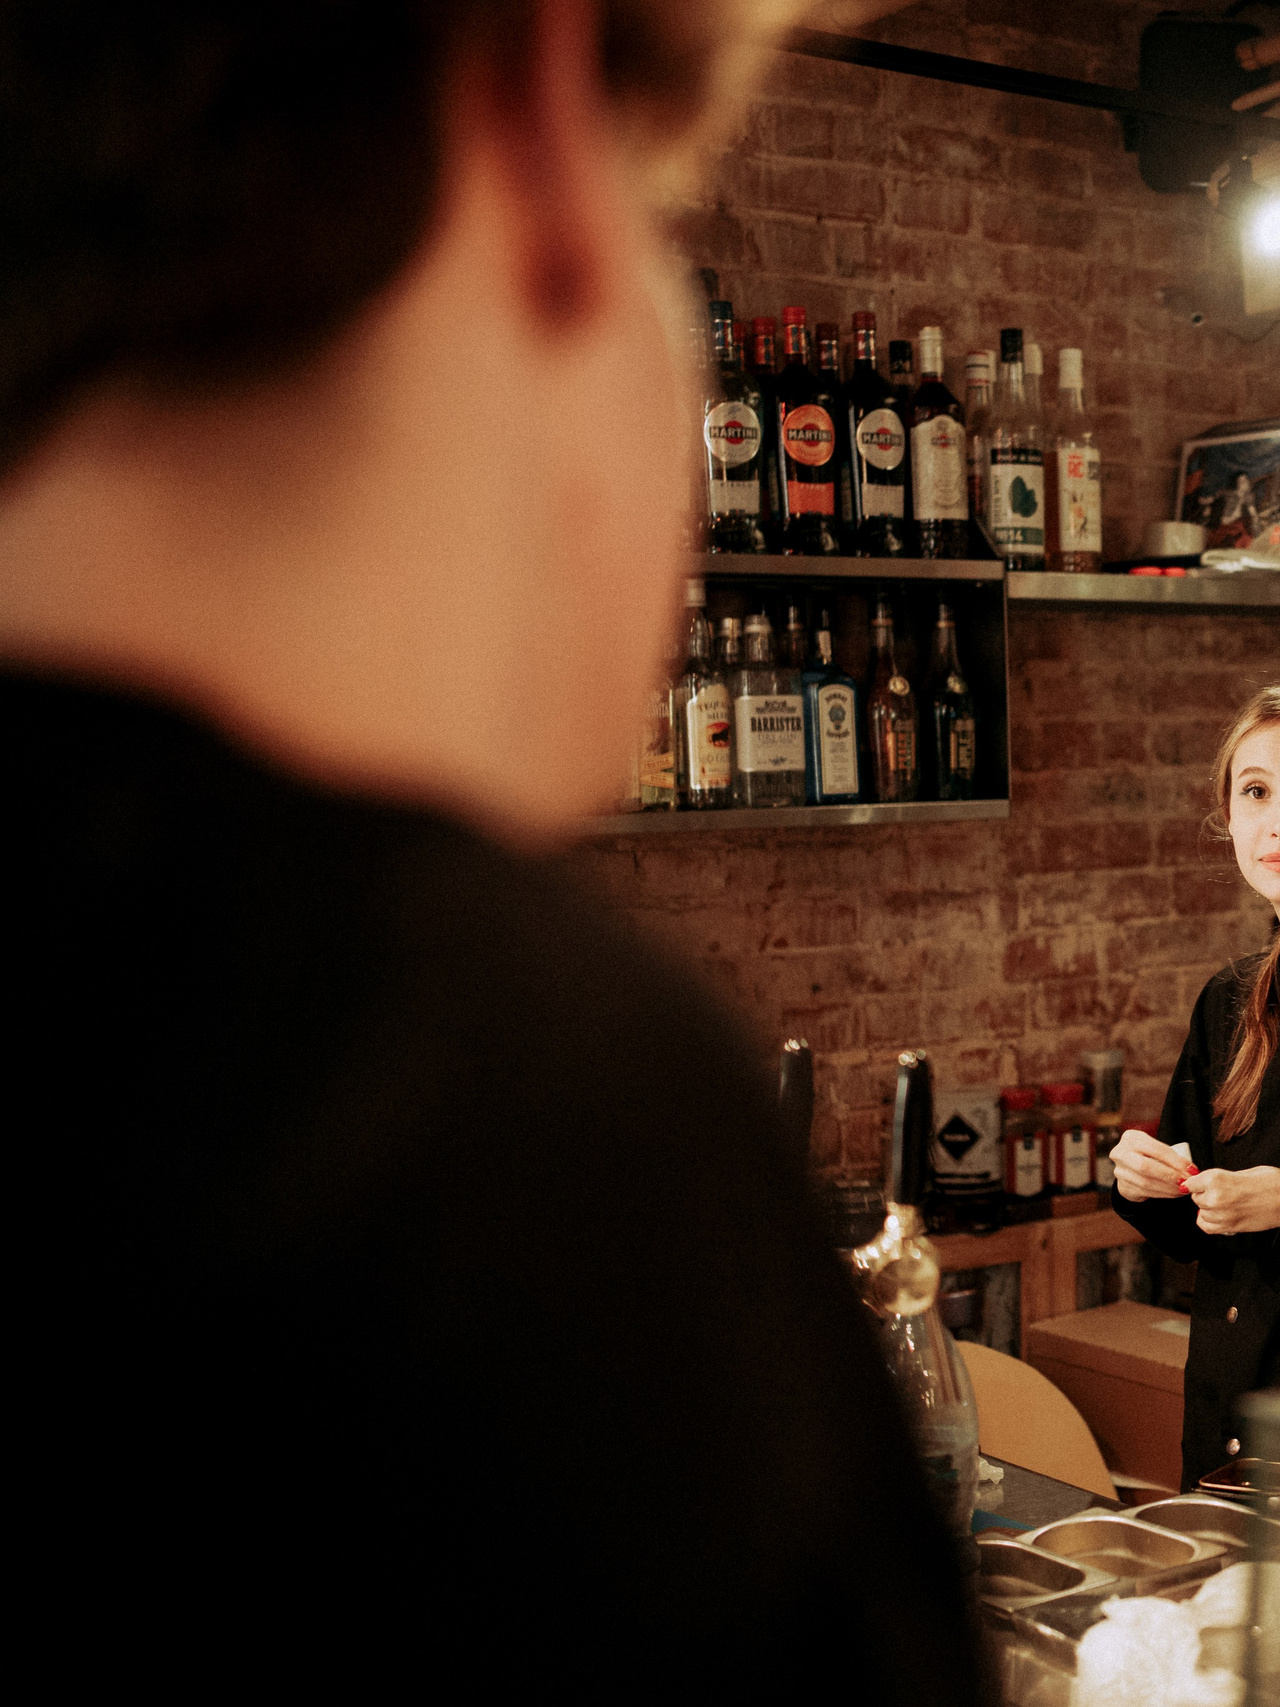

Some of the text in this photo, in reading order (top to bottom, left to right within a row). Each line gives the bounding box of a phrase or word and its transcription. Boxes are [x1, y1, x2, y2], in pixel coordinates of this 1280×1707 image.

[710, 427, 758, 439] MARTINI
[787, 429, 831, 441] MARTINI
[751, 717, 801, 732] BARRISTER
